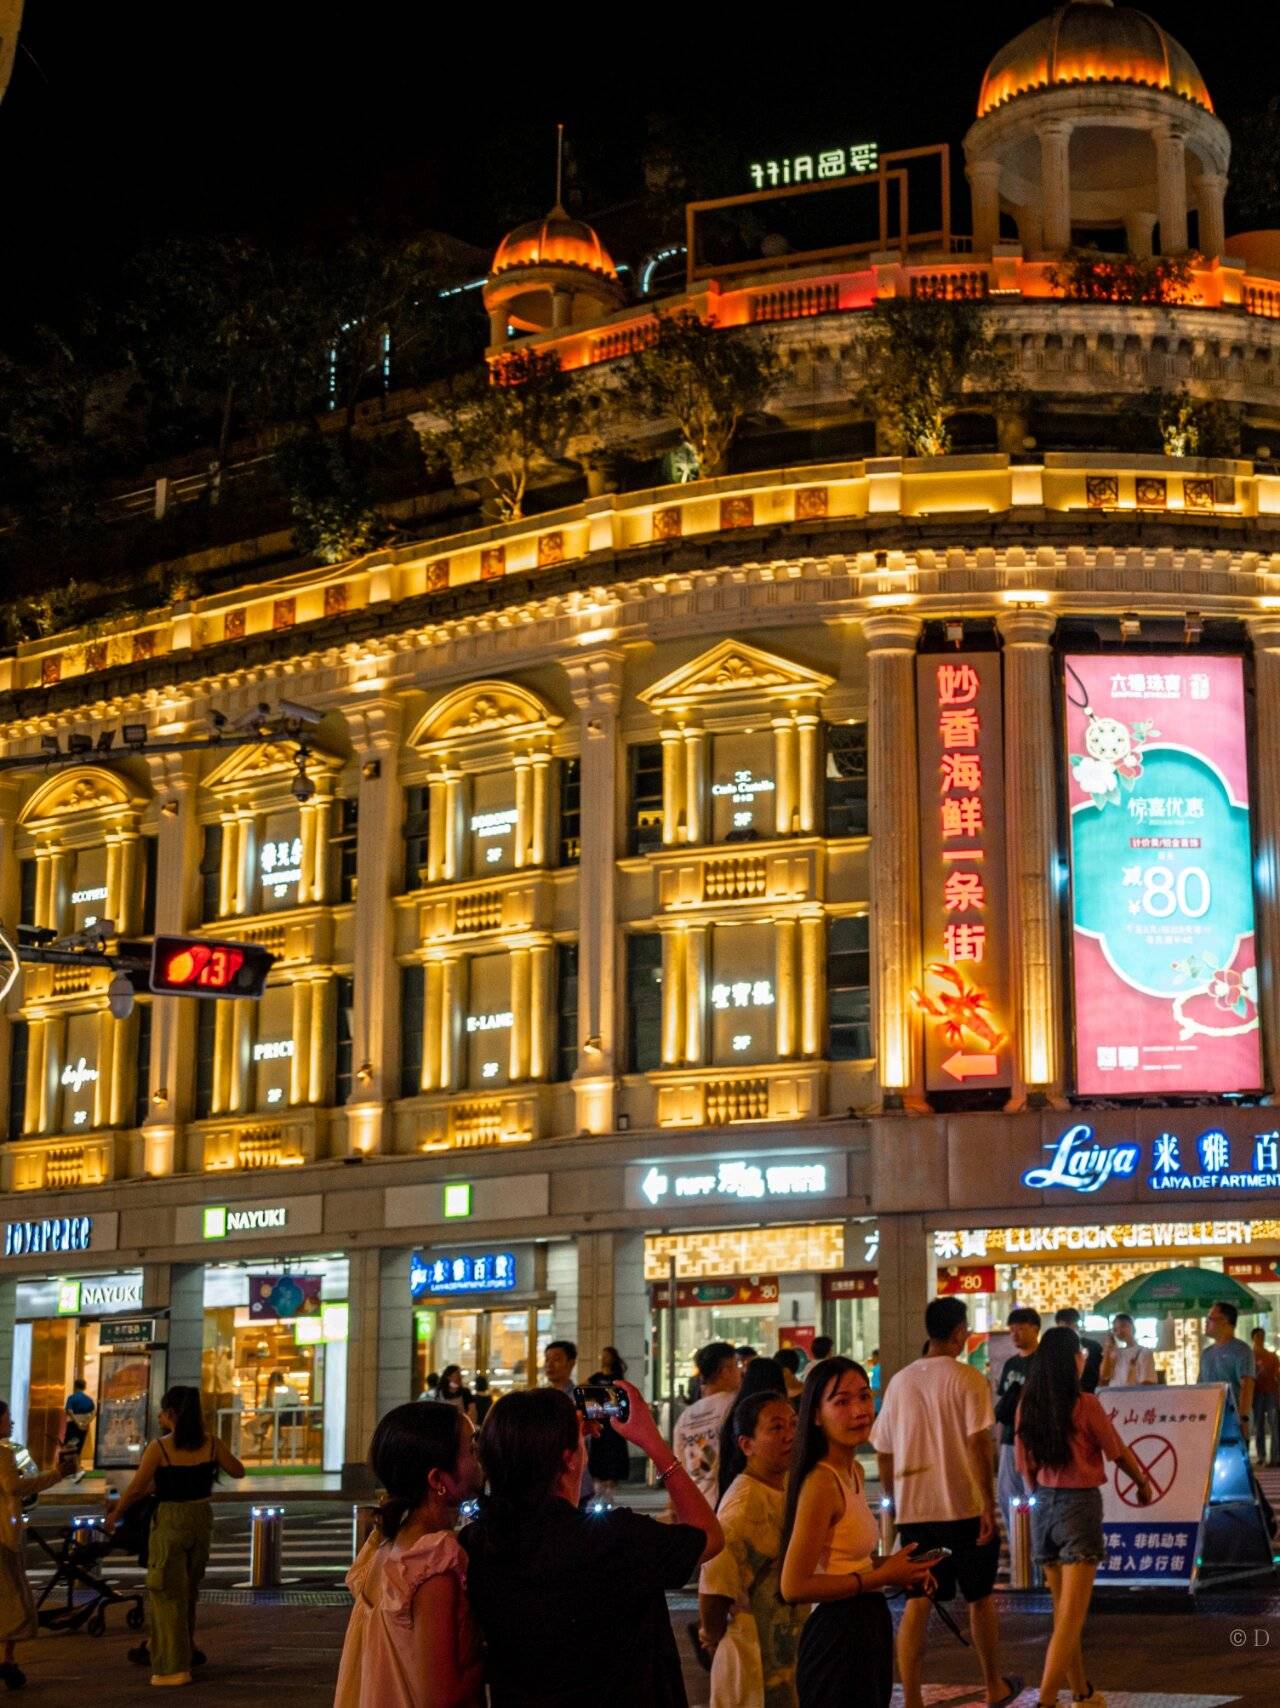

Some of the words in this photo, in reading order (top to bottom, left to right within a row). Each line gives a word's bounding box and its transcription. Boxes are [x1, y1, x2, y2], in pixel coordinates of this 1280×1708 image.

[935, 664, 987, 966] 妙香海鲜一条街
[1025, 1125, 1137, 1192] Laiya
[1152, 1177, 1191, 1190] LAIYA
[227, 1208, 286, 1230] NAYUKI
[1005, 1226, 1118, 1252] LUKFOOK
[1122, 1220, 1252, 1248] JEWELLERY
